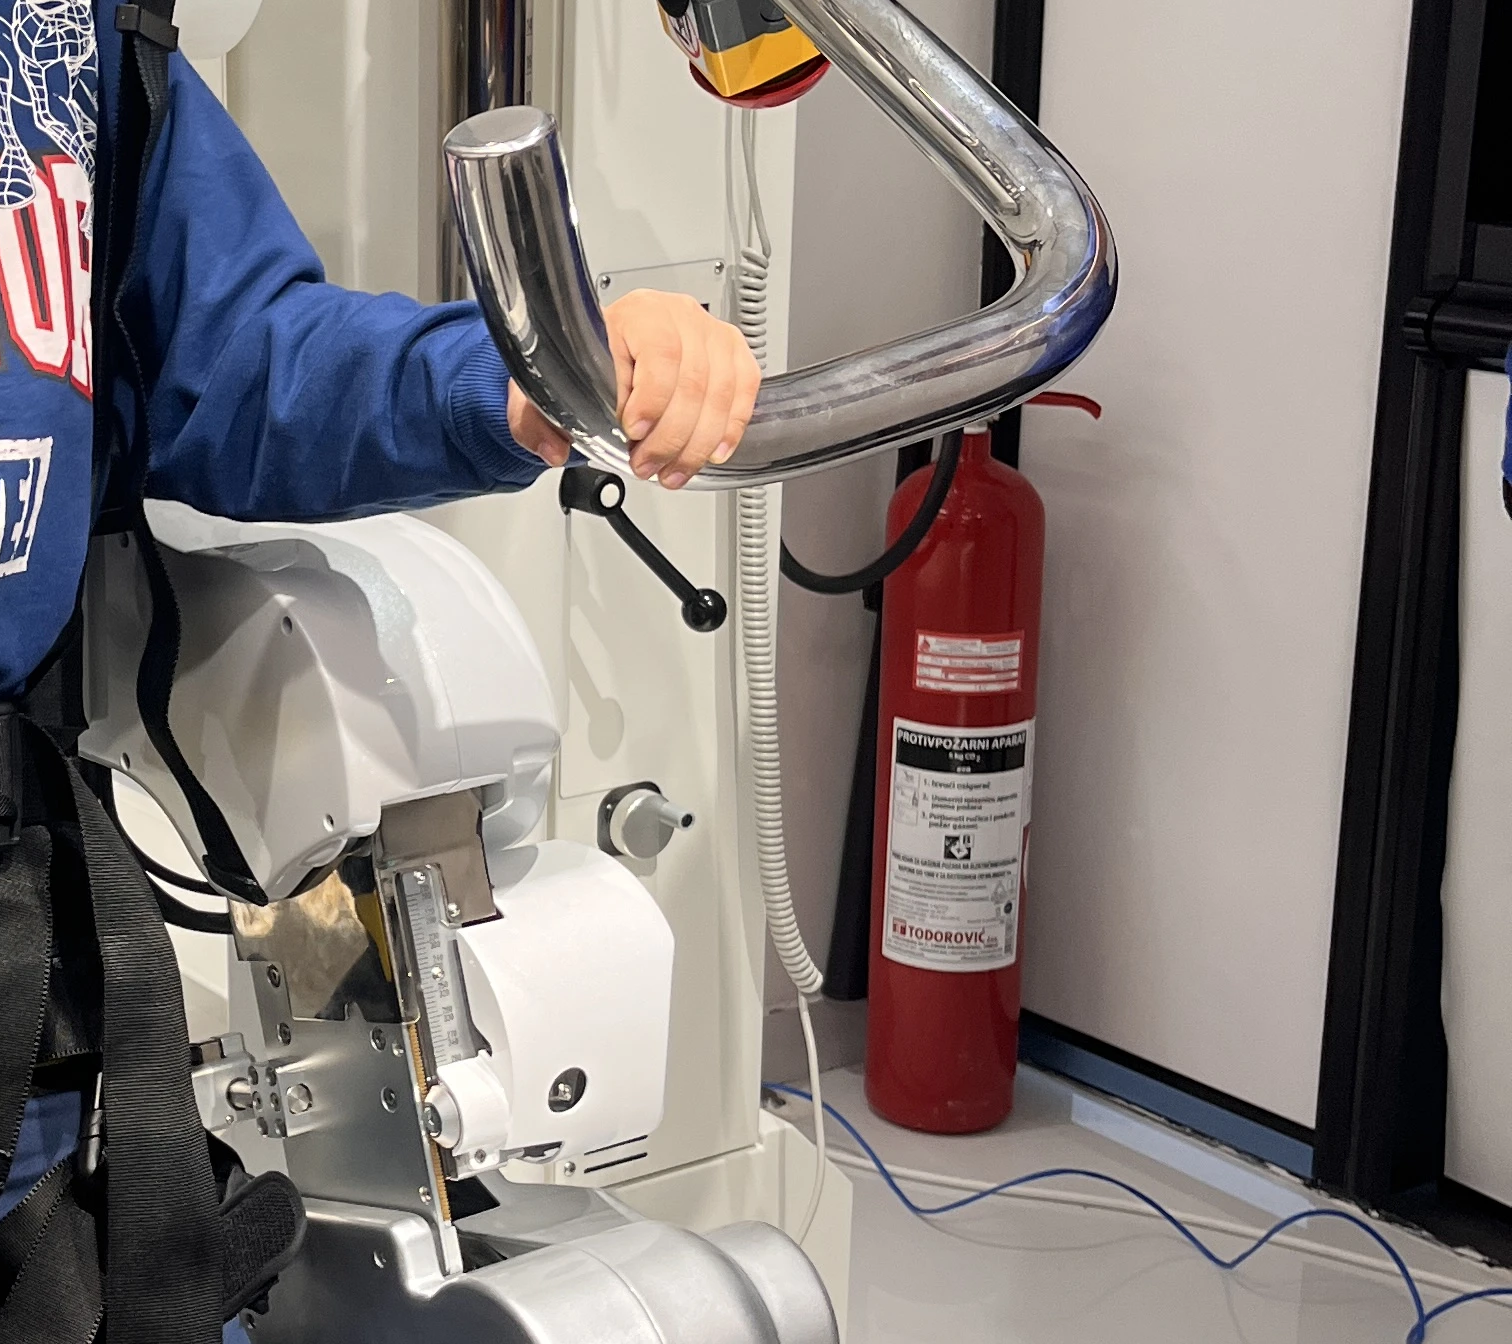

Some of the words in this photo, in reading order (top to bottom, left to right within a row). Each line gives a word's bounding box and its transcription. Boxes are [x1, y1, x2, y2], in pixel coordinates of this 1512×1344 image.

[897, 729, 990, 751] PROTIVPOŽARNI
[991, 733, 1025, 751] APARAT
[908, 925, 986, 944] TODOROVIĆ
